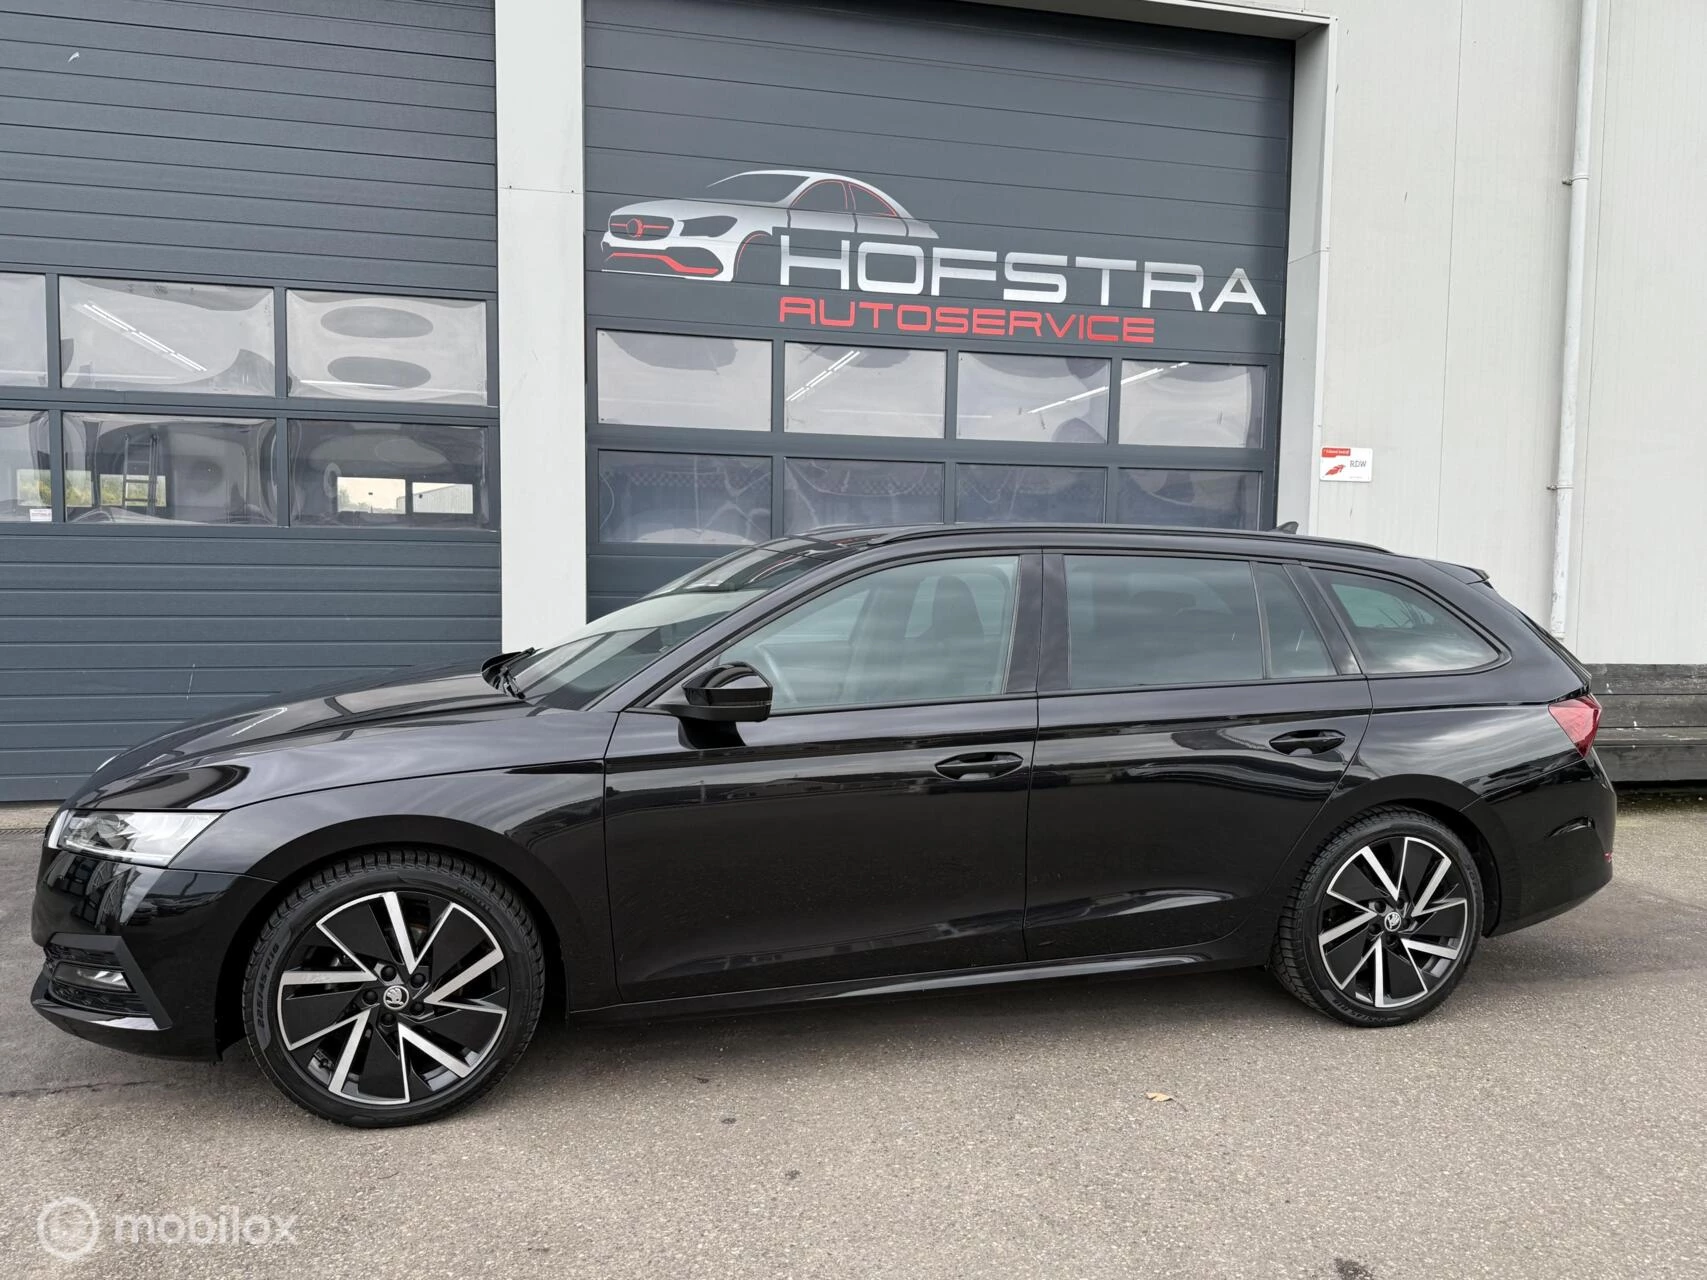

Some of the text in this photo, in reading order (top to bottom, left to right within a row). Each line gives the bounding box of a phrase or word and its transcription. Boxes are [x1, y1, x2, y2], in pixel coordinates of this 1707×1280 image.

[779, 235, 1267, 315] HOFSTRA
[779, 297, 1155, 343] AUTOSERVICE
[1350, 460, 1367, 468] RDW
